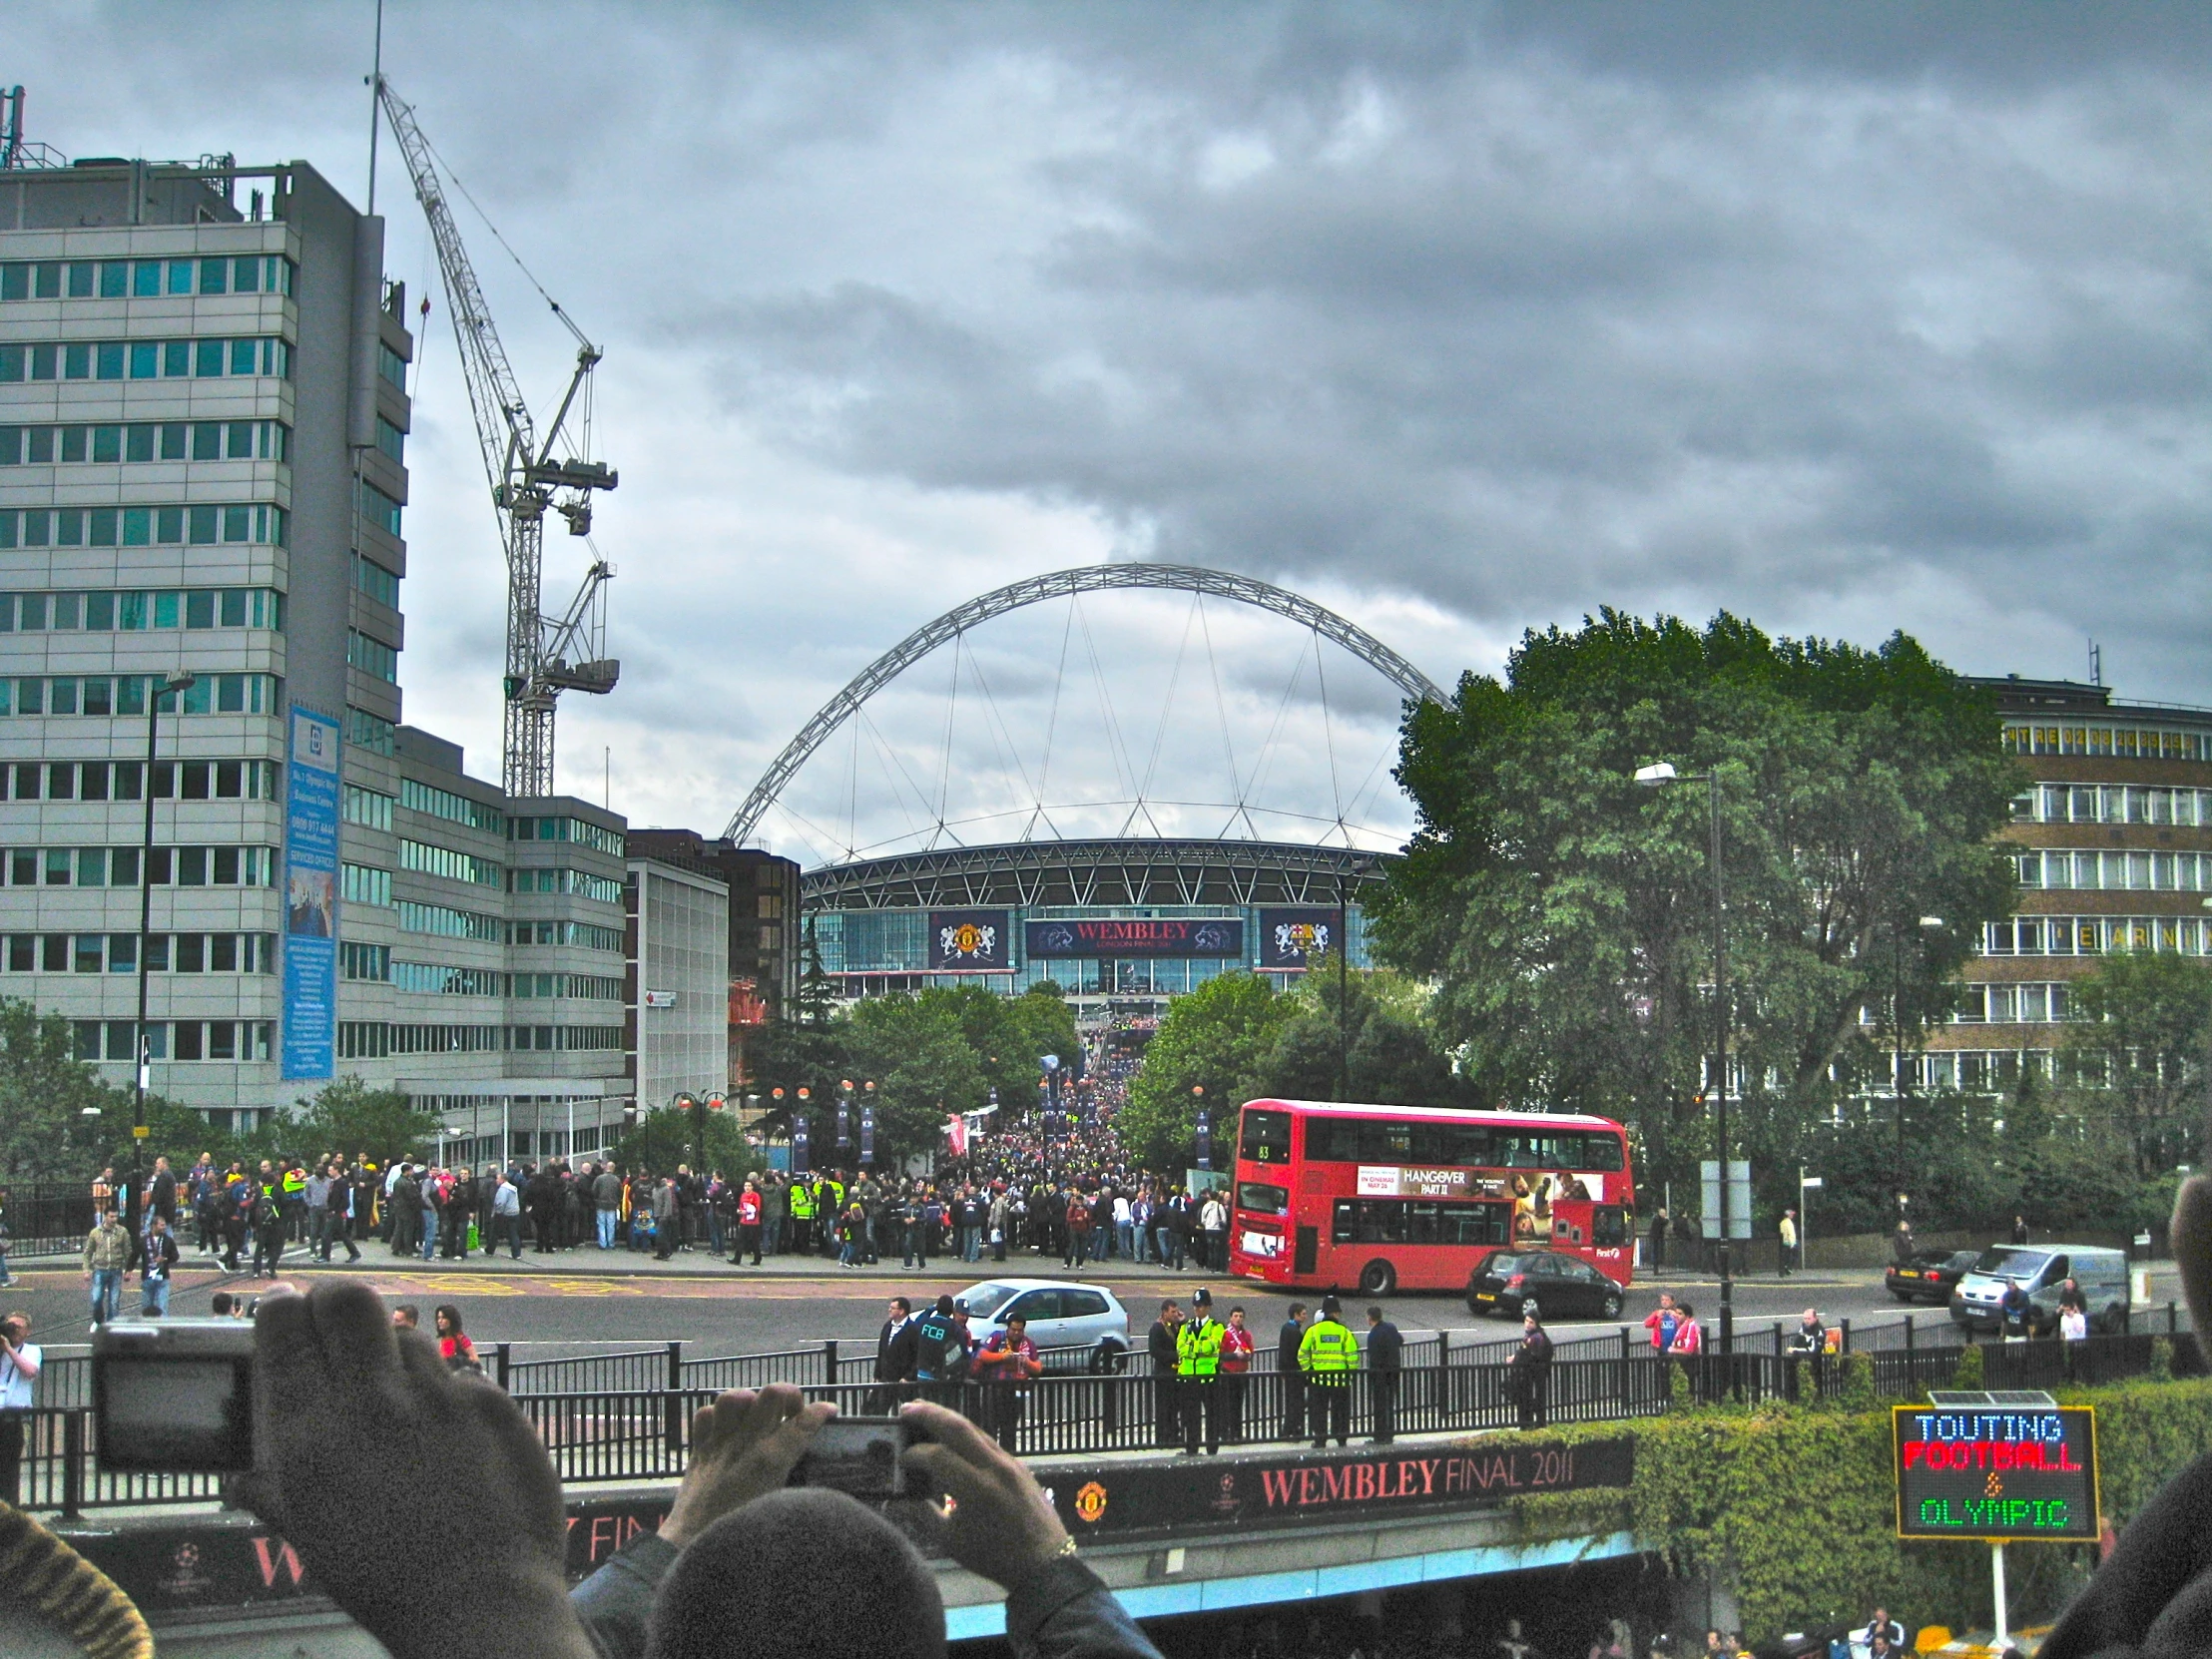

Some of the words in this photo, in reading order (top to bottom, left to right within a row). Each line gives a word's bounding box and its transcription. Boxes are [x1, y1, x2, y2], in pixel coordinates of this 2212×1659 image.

[290, 849, 315, 865] SERVICED
[315, 855, 334, 868] OFFICES
[1077, 922, 1191, 939] WEMBLEY
[1258, 1146, 1269, 1159] 83
[1403, 1169, 1465, 1184] HANGOVER
[1420, 1184, 1438, 1195] PART
[1439, 1185, 1448, 1195] II
[1596, 1248, 1612, 1258] First
[921, 1324, 944, 1341] FCB
[1915, 1414, 2062, 1440] TOUTING
[1904, 1440, 2082, 1471] FOOTBALL
[1261, 1459, 1441, 1507] WEMBLEY
[1444, 1454, 1523, 1492] FINAL
[1531, 1451, 1573, 1485] 2011
[1983, 1471, 2003, 1497] &
[1920, 1498, 2068, 1527] OLYMPIC
